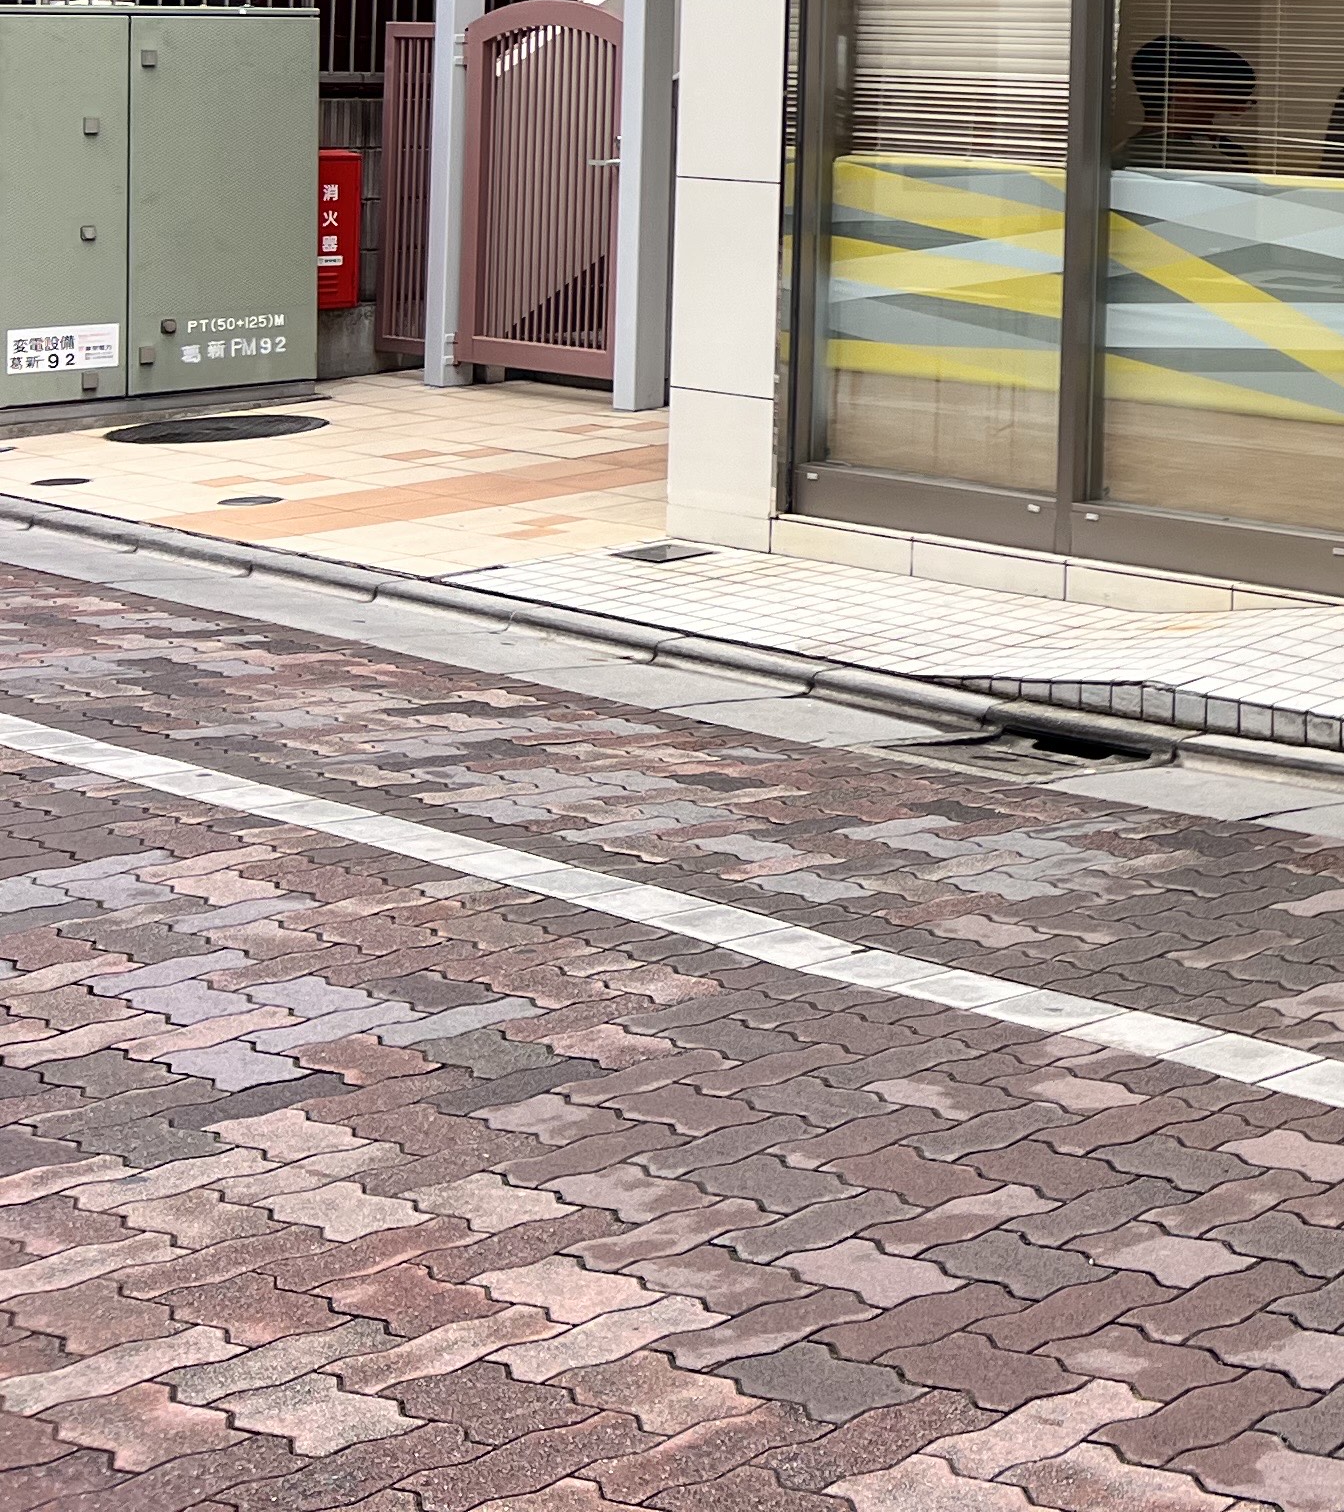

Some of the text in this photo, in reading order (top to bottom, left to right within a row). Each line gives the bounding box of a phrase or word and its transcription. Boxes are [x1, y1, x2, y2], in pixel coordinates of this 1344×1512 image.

[322, 184, 339, 252] 消火器
[13, 335, 75, 354] 変電設備
